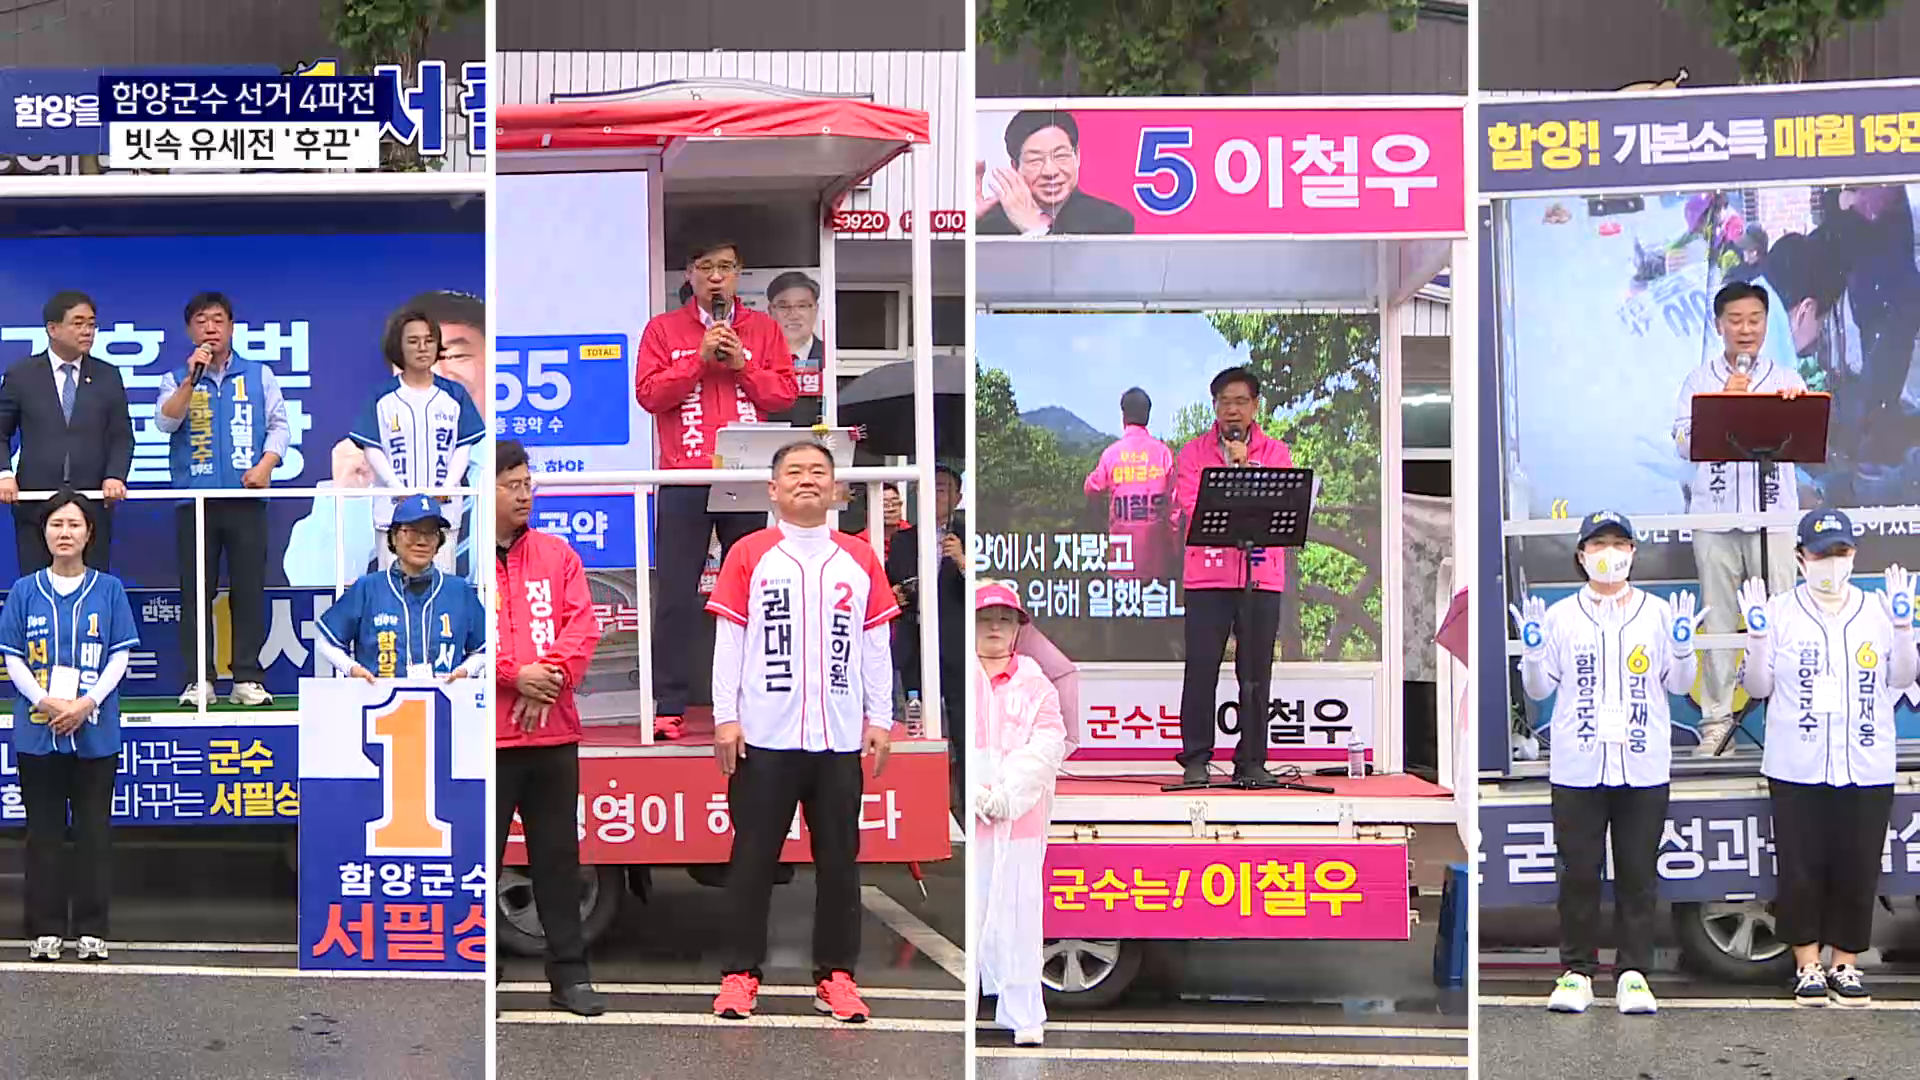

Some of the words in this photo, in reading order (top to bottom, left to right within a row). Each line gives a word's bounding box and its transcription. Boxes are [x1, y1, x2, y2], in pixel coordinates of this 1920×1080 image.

[1488, 119, 1600, 171] 함양!
[1613, 119, 1768, 165] 기본소득
[1774, 114, 1855, 157] 매월
[1133, 127, 1197, 215] 5
[1214, 133, 1438, 209] 이철우
[231, 375, 249, 401] 1
[512, 416, 543, 434] 공약
[548, 416, 564, 434] 수
[1053, 532, 1135, 572] 자랐고
[834, 582, 853, 613] 2
[1026, 579, 1080, 617] 위해
[1891, 592, 1912, 620] 6
[87, 612, 99, 637] 1
[440, 613, 453, 638] 1
[1523, 621, 1543, 648] 6
[1673, 616, 1692, 643] 6
[1747, 605, 1768, 631] 6
[762, 587, 793, 693] 권대근
[829, 613, 851, 689] 도의원
[1855, 641, 1878, 669] 6
[1626, 643, 1651, 675] 6
[1575, 652, 1597, 743] 함양군수
[1628, 676, 1648, 753] 김재웅
[1858, 671, 1876, 748] 김재웅
[208, 739, 274, 775] 군수
[363, 688, 451, 856] 1
[110, 783, 204, 818] 바꾸는
[1048, 867, 1192, 911] 군수는!
[1201, 860, 1364, 917] 이철우
